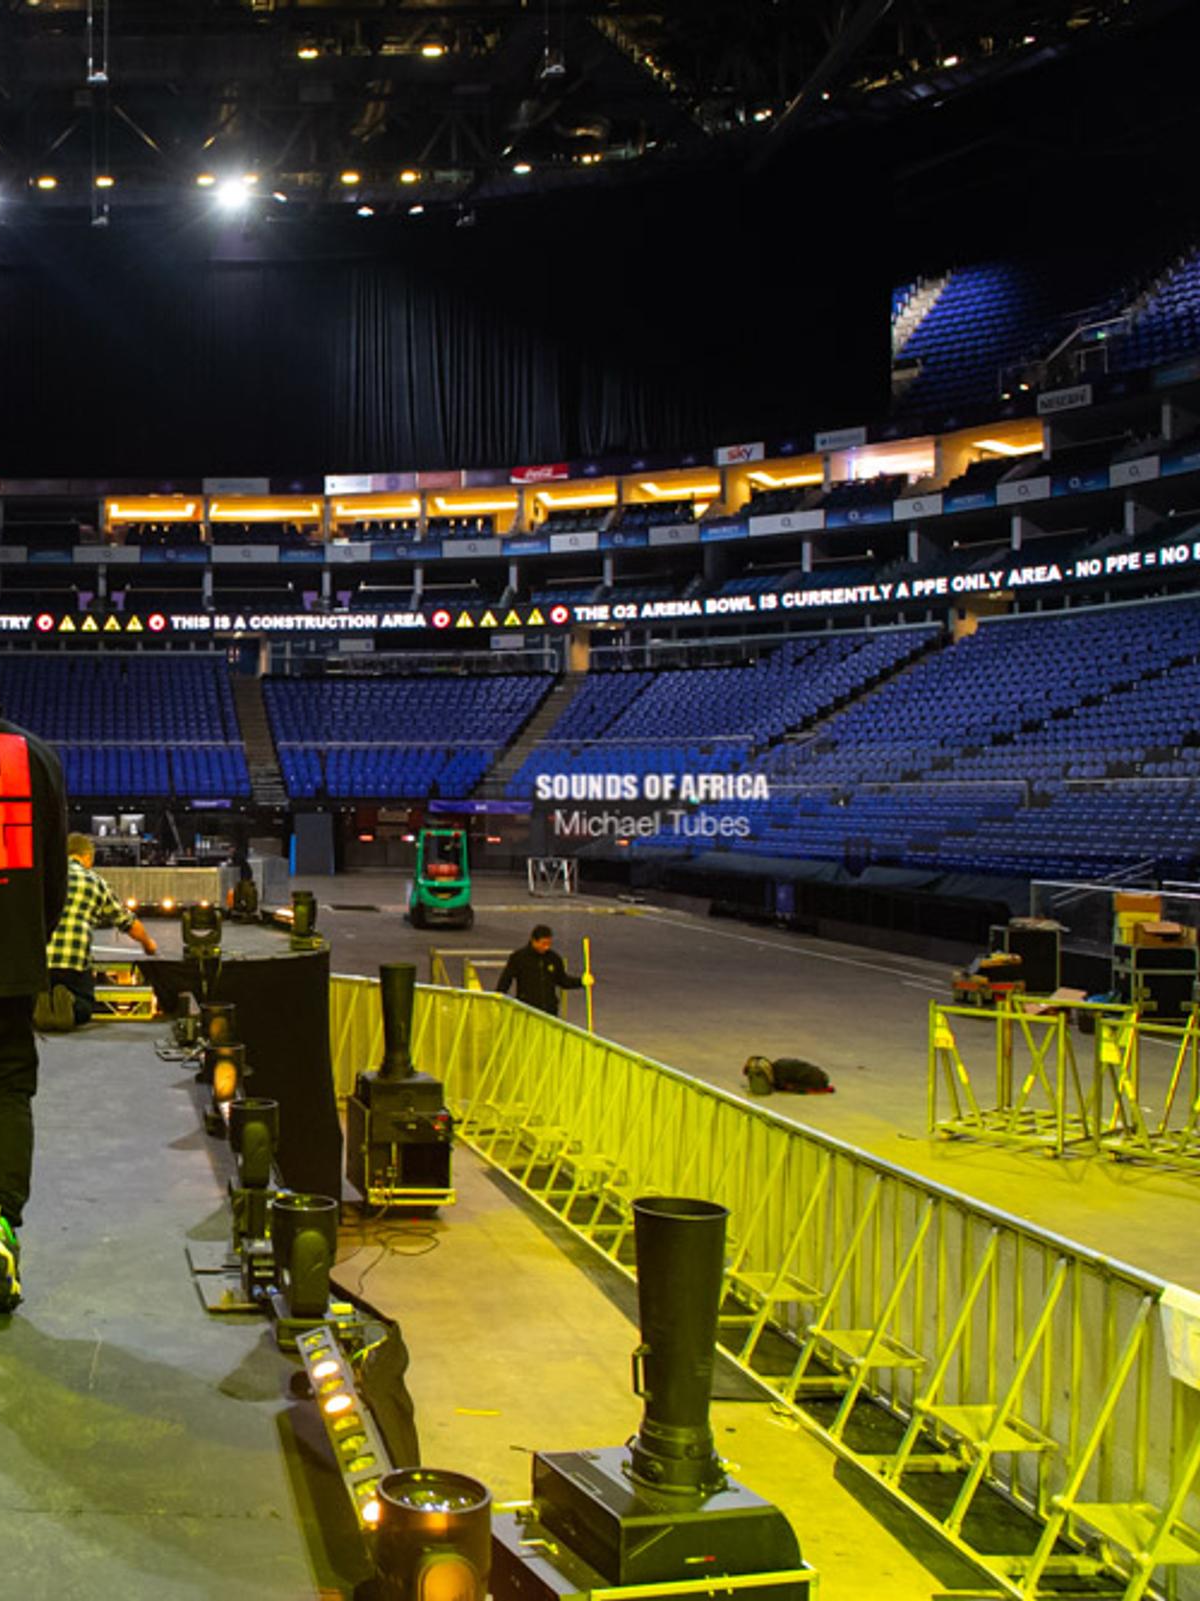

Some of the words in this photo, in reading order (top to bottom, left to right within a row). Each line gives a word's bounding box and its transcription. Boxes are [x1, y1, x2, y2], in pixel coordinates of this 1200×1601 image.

[728, 446, 753, 461] sky
[574, 606, 609, 620] THE
[641, 601, 702, 617] ARENA
[705, 598, 755, 613] BOWL
[760, 594, 777, 609] IS
[783, 584, 892, 606] CURRENTLY
[897, 583, 909, 598] A
[913, 578, 947, 596] PPE
[952, 572, 1002, 591] ONLY
[1009, 565, 1061, 585] AREA
[1077, 559, 1101, 577] NO
[1107, 552, 1140, 573] PPE
[1162, 545, 1189, 564] NO
[171, 616, 210, 629] THIS
[214, 616, 230, 629] IS
[234, 616, 246, 629] A
[250, 614, 377, 629] CONSTRUCTION
[381, 614, 426, 627] AREA
